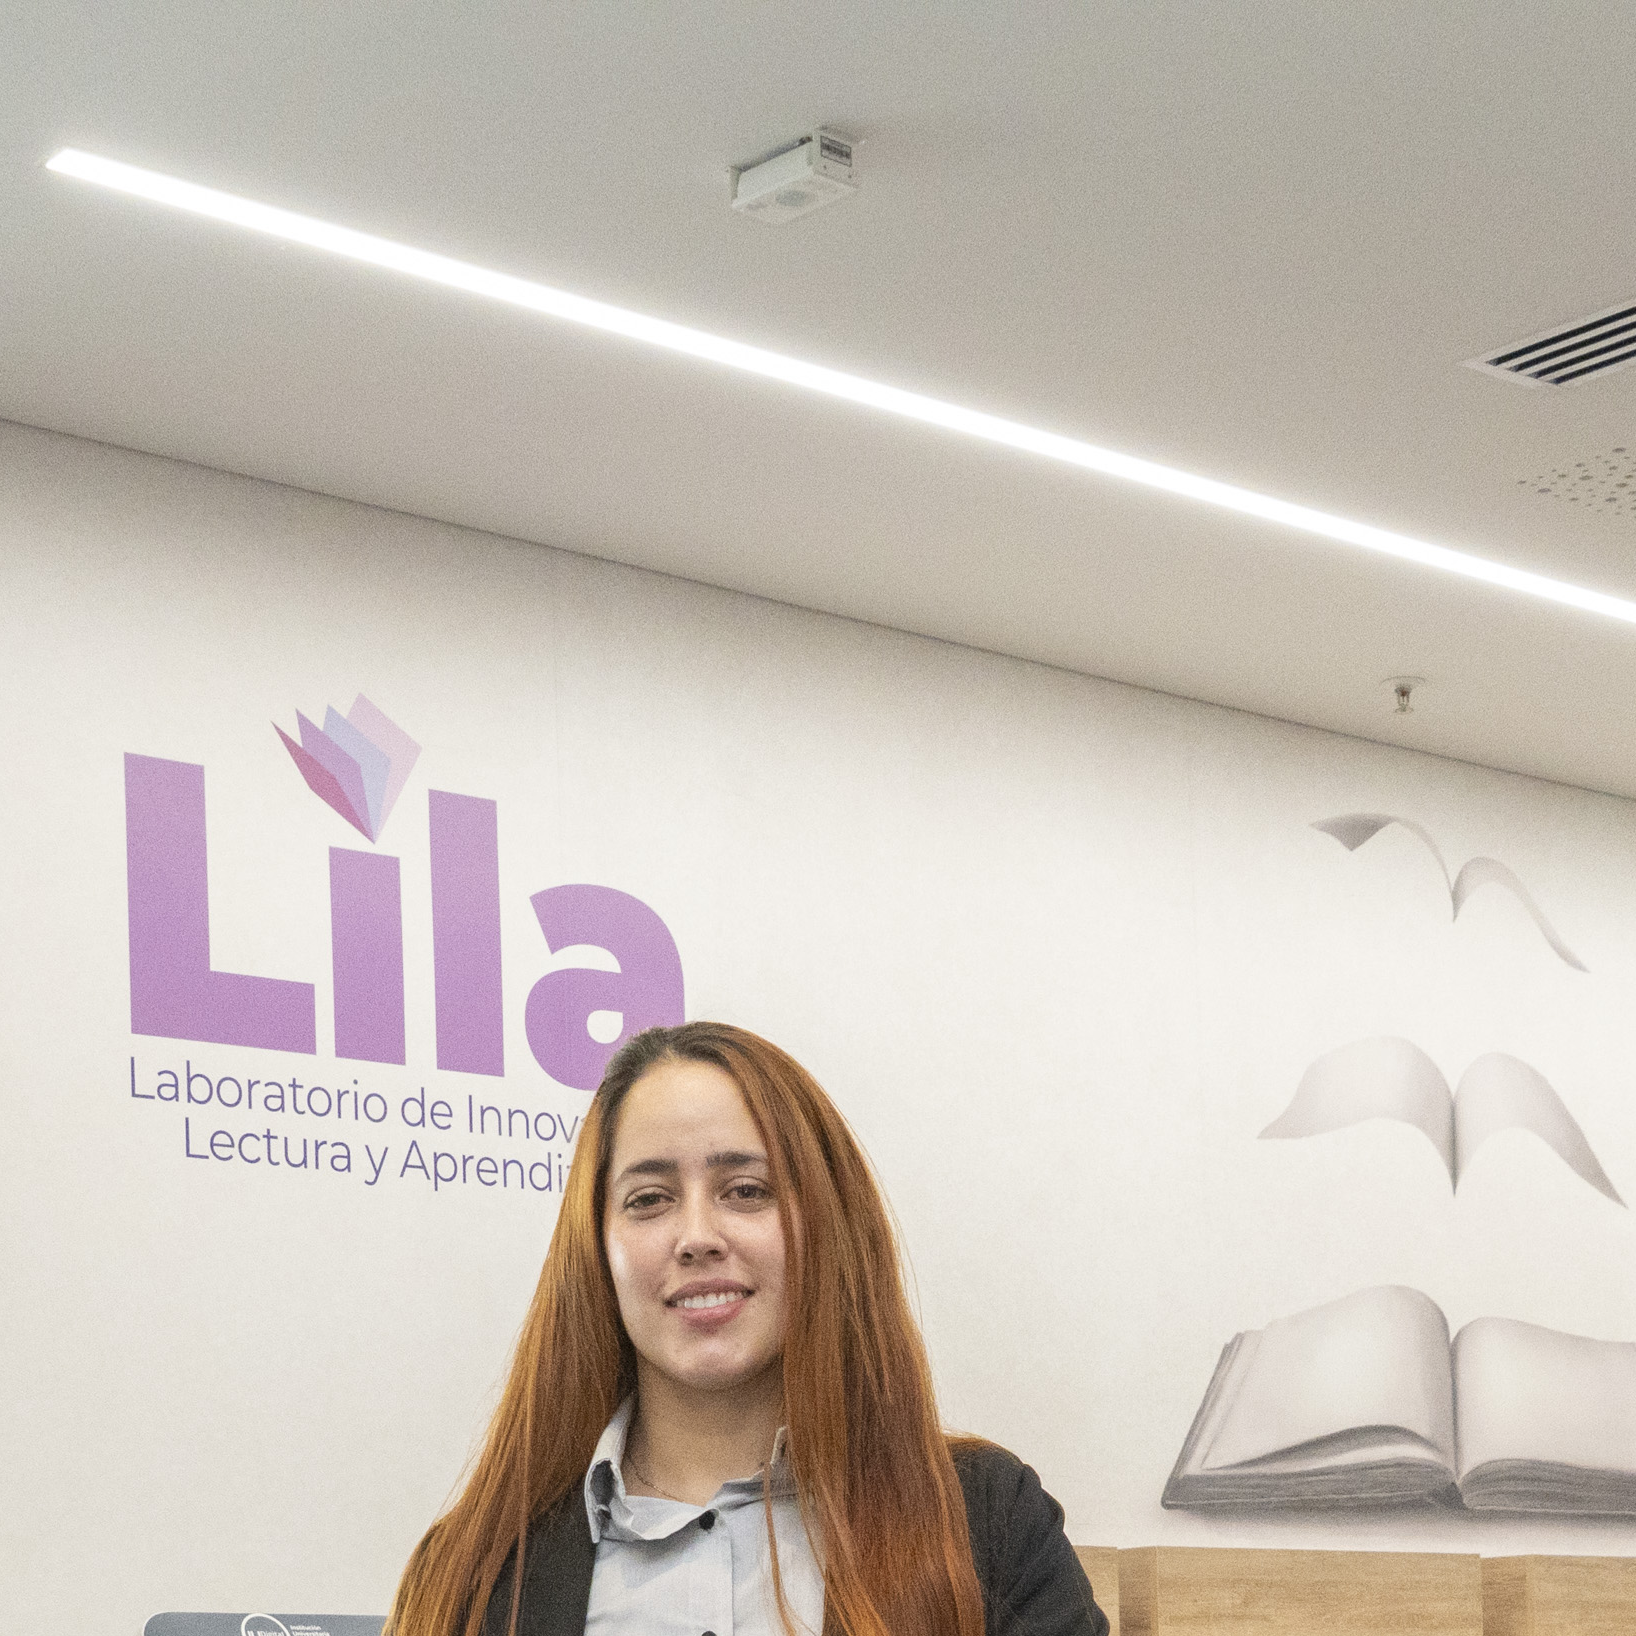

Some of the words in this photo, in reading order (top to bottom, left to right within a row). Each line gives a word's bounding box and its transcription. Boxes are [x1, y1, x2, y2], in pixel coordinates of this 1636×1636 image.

[123, 750, 686, 1092] Lila
[130, 1055, 389, 1124] Laboratorio
[401, 1086, 453, 1131] de
[468, 1093, 589, 1144] Innov
[184, 1116, 353, 1174] Lectura
[363, 1142, 389, 1186] y
[399, 1139, 571, 1194] Aprendi
